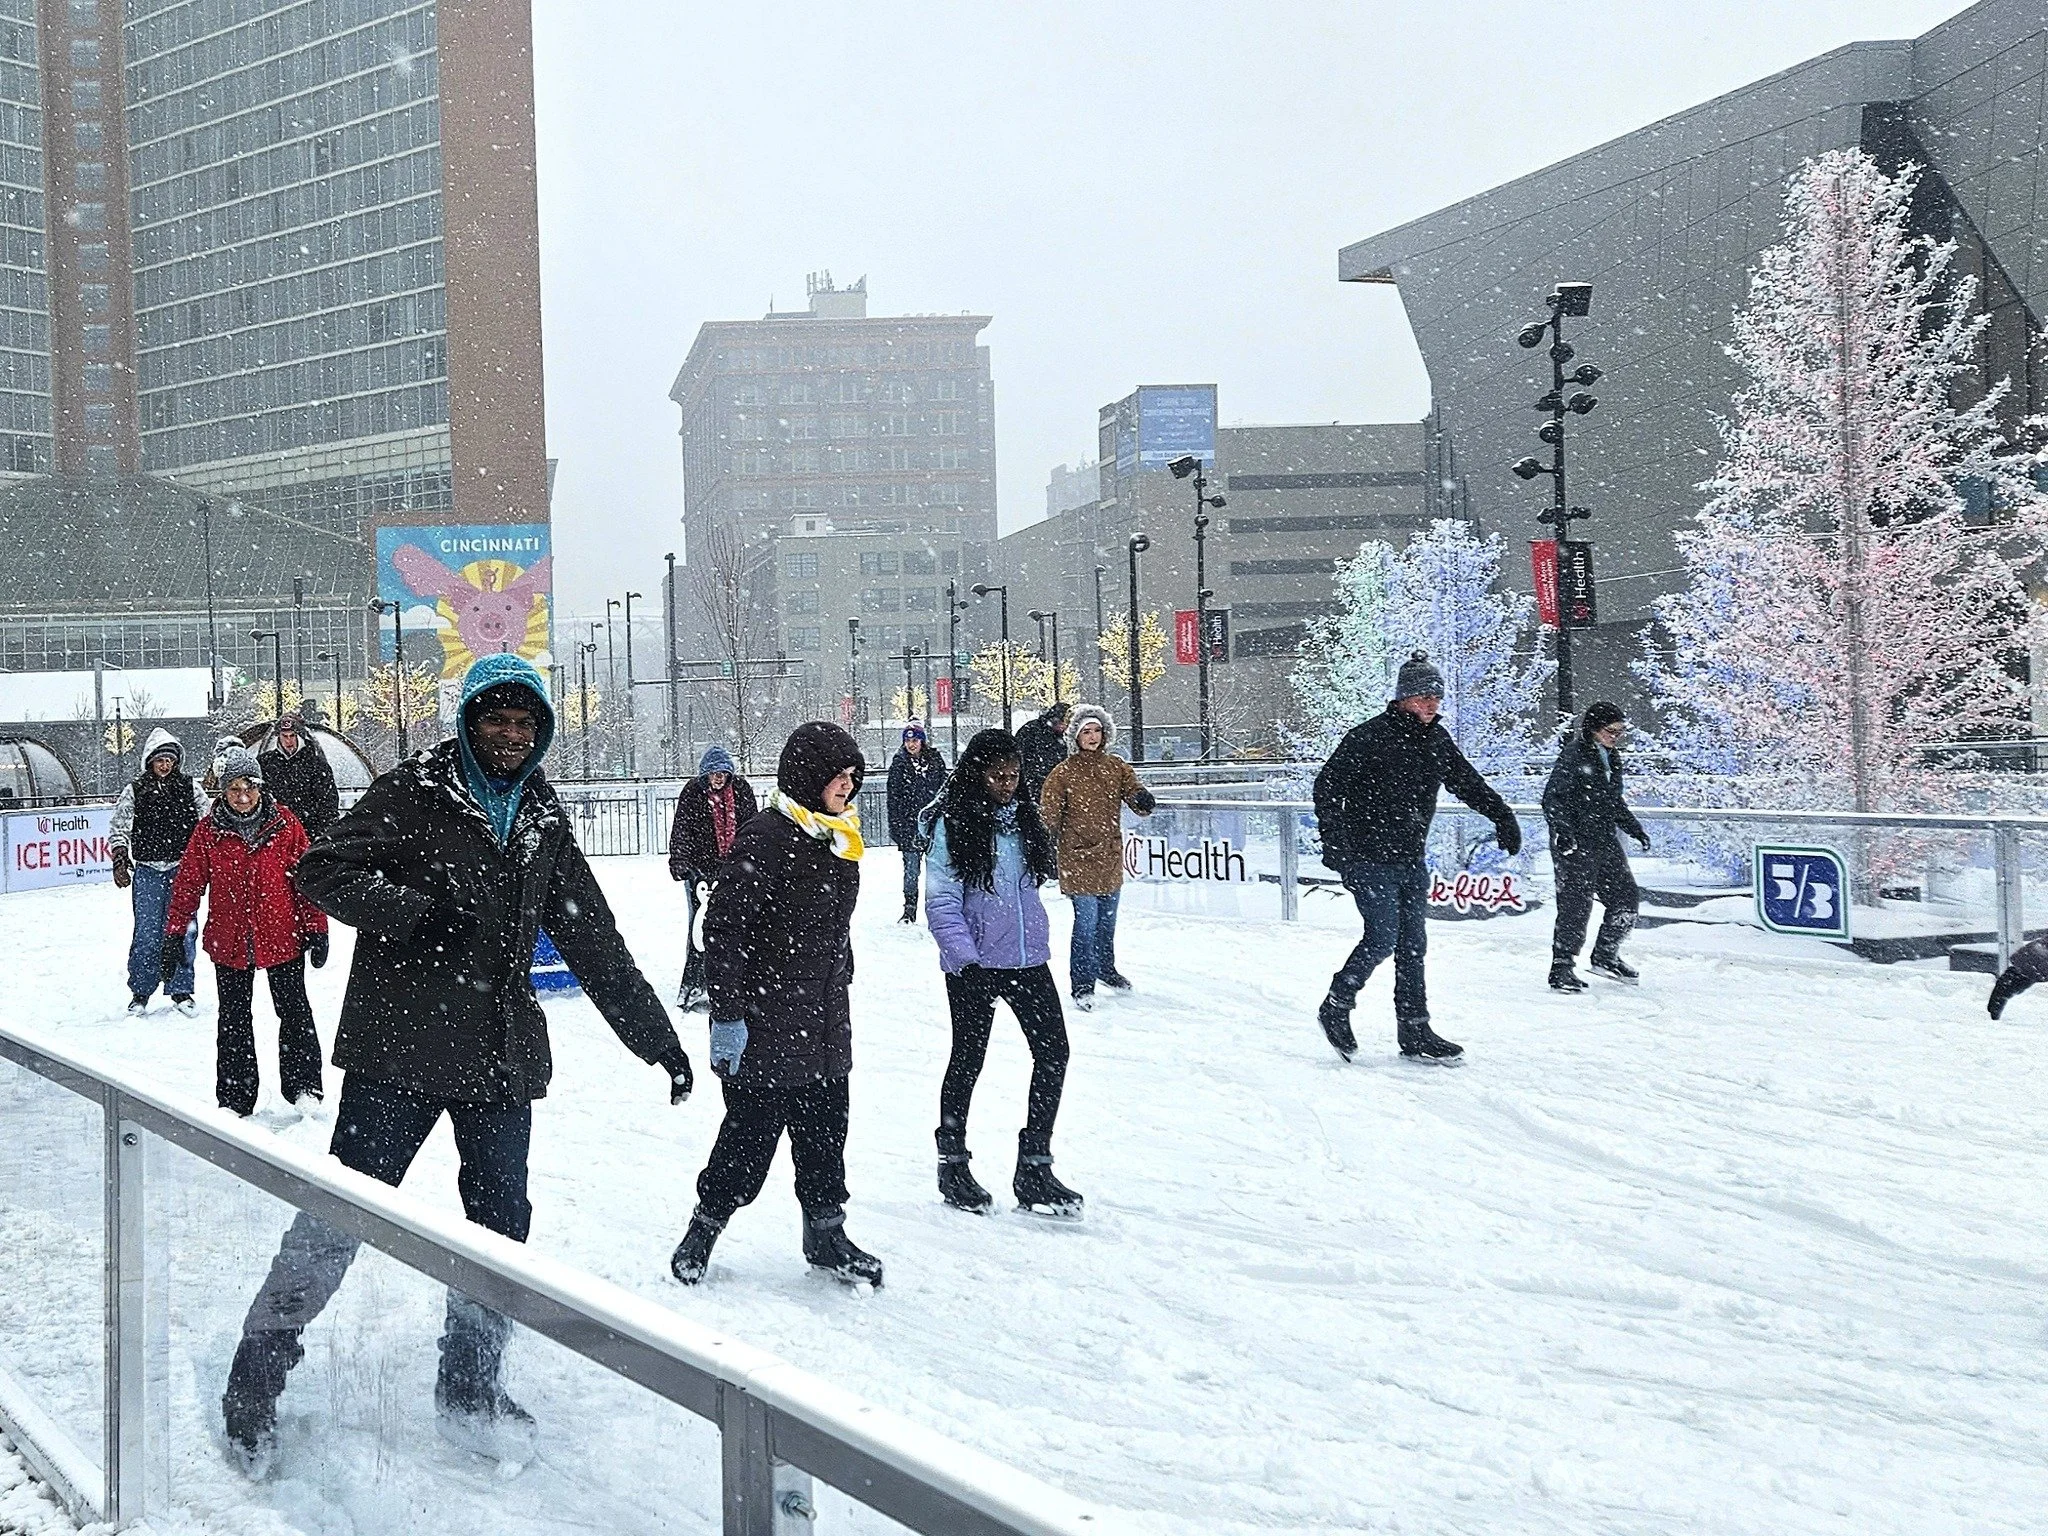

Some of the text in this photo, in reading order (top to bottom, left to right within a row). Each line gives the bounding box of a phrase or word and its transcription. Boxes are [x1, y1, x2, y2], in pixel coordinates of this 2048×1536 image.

[441, 538, 540, 552] CINCINNATI
[1573, 551, 1587, 599] Health
[1211, 615, 1223, 645] Health
[52, 815, 89, 833] Health
[17, 837, 113, 871] ICE RINK
[1148, 839, 1246, 882] Health
[1427, 874, 1523, 910] k-fil-A
